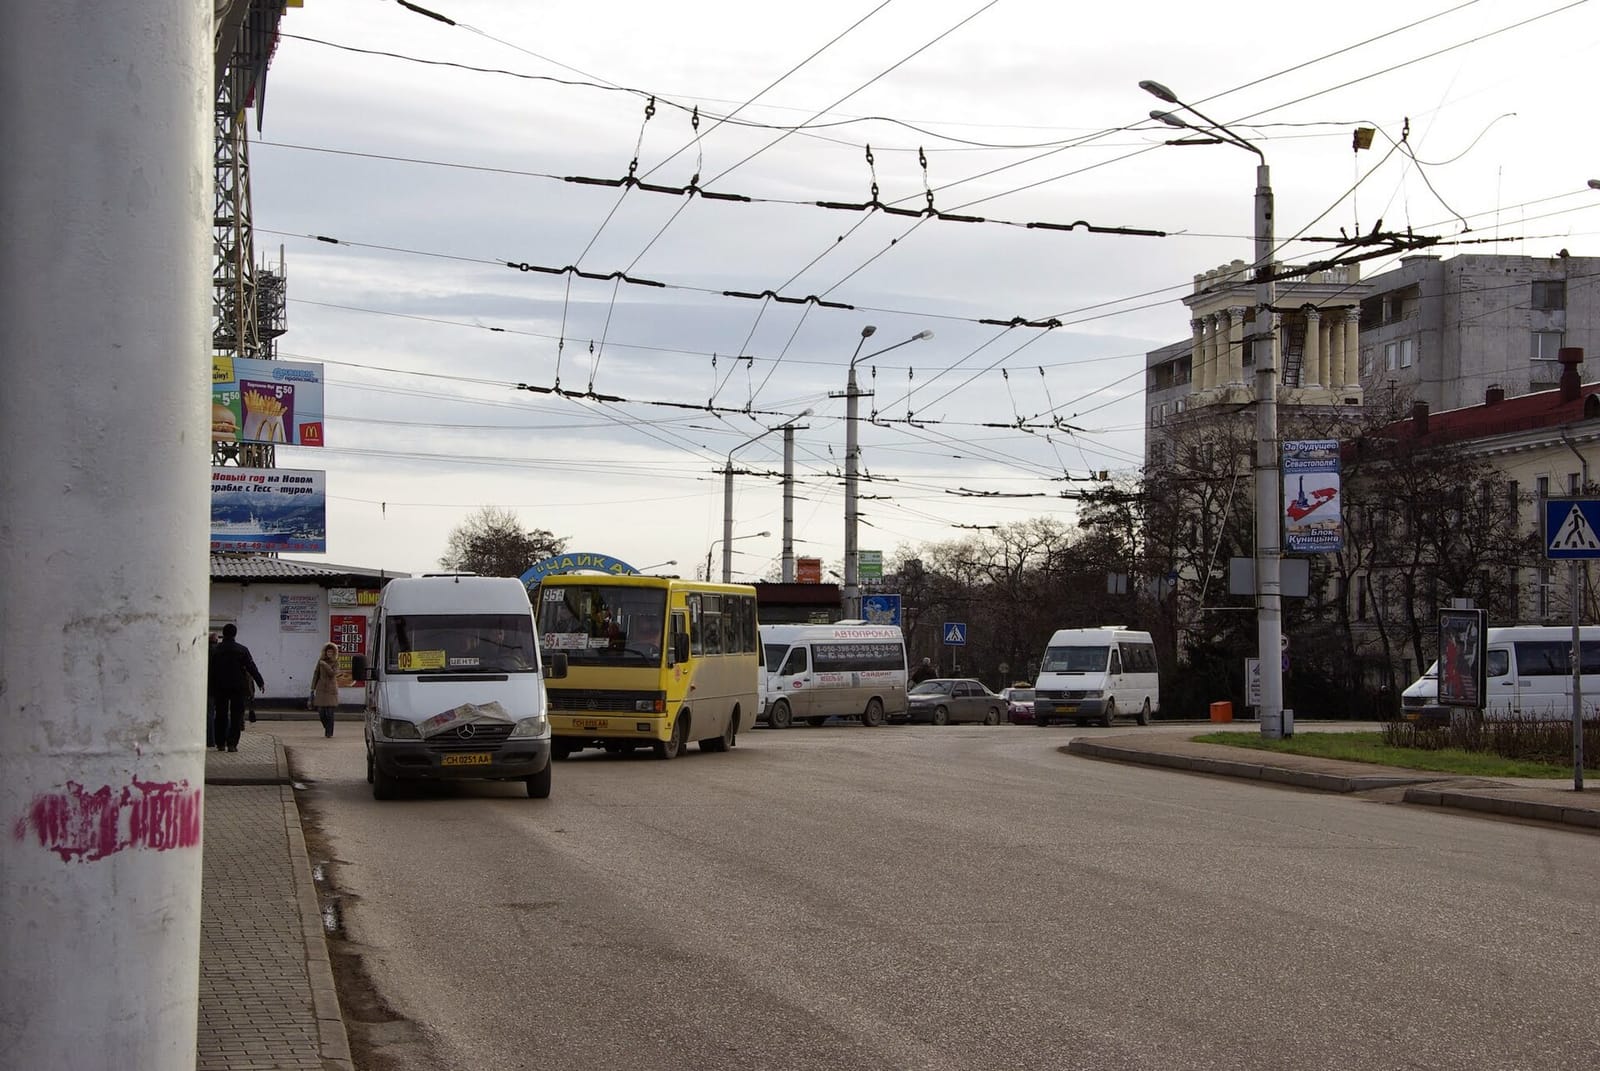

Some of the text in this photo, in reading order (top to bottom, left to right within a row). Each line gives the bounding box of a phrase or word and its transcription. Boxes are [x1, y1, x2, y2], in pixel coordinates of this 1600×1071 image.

[1298, 442, 1337, 452] будущее
[212, 472, 246, 482] Новый
[248, 475, 265, 484] год
[282, 475, 313, 484] Новом
[1289, 536, 1339, 544] Куницына
[834, 630, 895, 638] АВТОПРОКАТ
[400, 653, 412, 668] 109
[459, 756, 476, 764] 0251
[478, 755, 489, 763] AA
